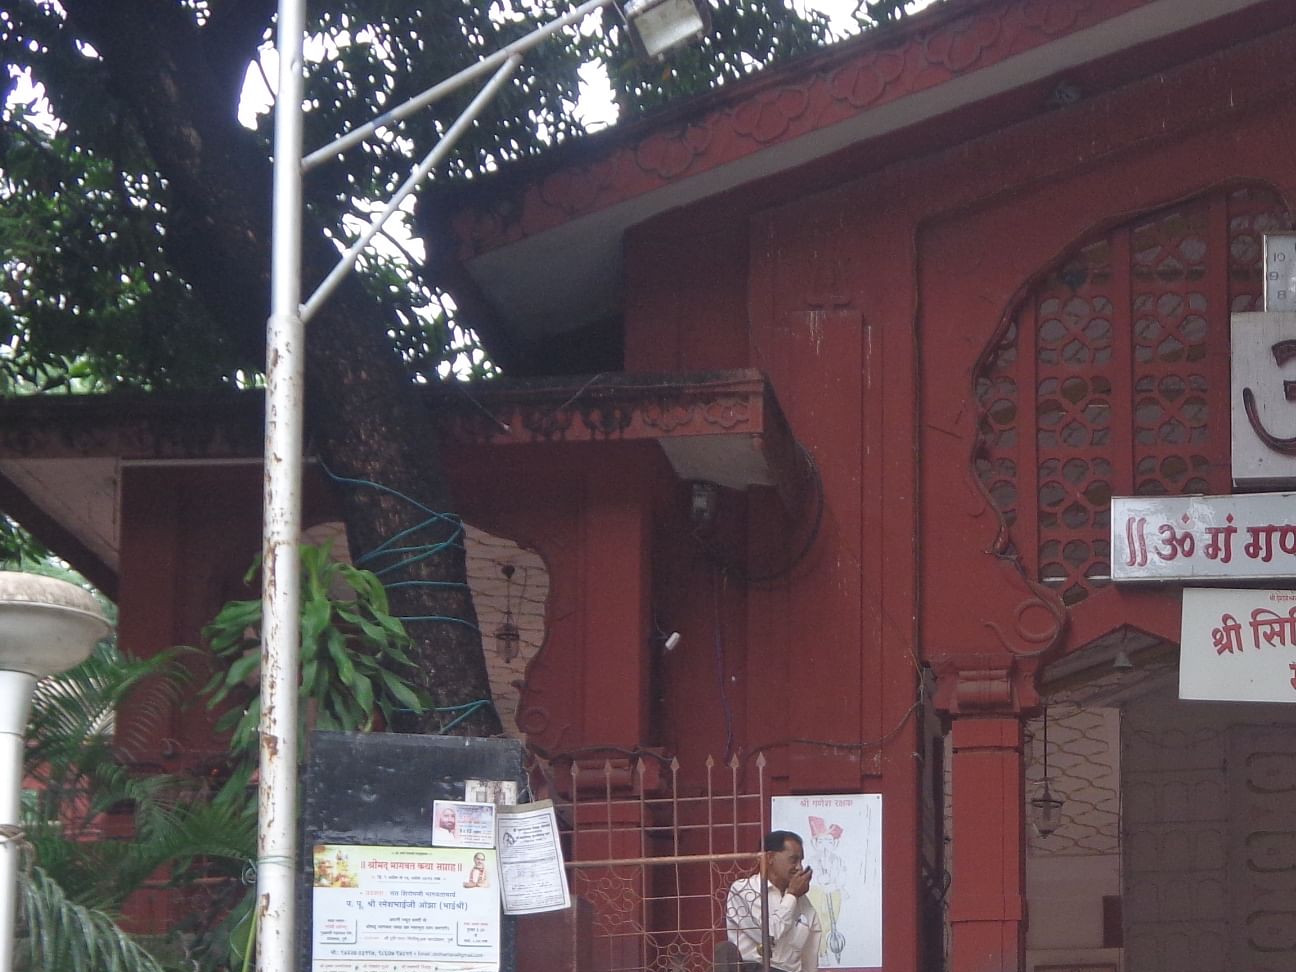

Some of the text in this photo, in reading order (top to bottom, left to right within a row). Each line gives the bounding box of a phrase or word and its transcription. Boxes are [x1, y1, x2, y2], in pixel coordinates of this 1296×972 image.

[1273, 252, 1286, 262] 10
[1269, 271, 1279, 280] 9
[1277, 289, 1287, 299] 8
[1204, 513, 1238, 563] गं
[1211, 613, 1244, 656] श्री
[812, 799, 831, 808] गणेश
